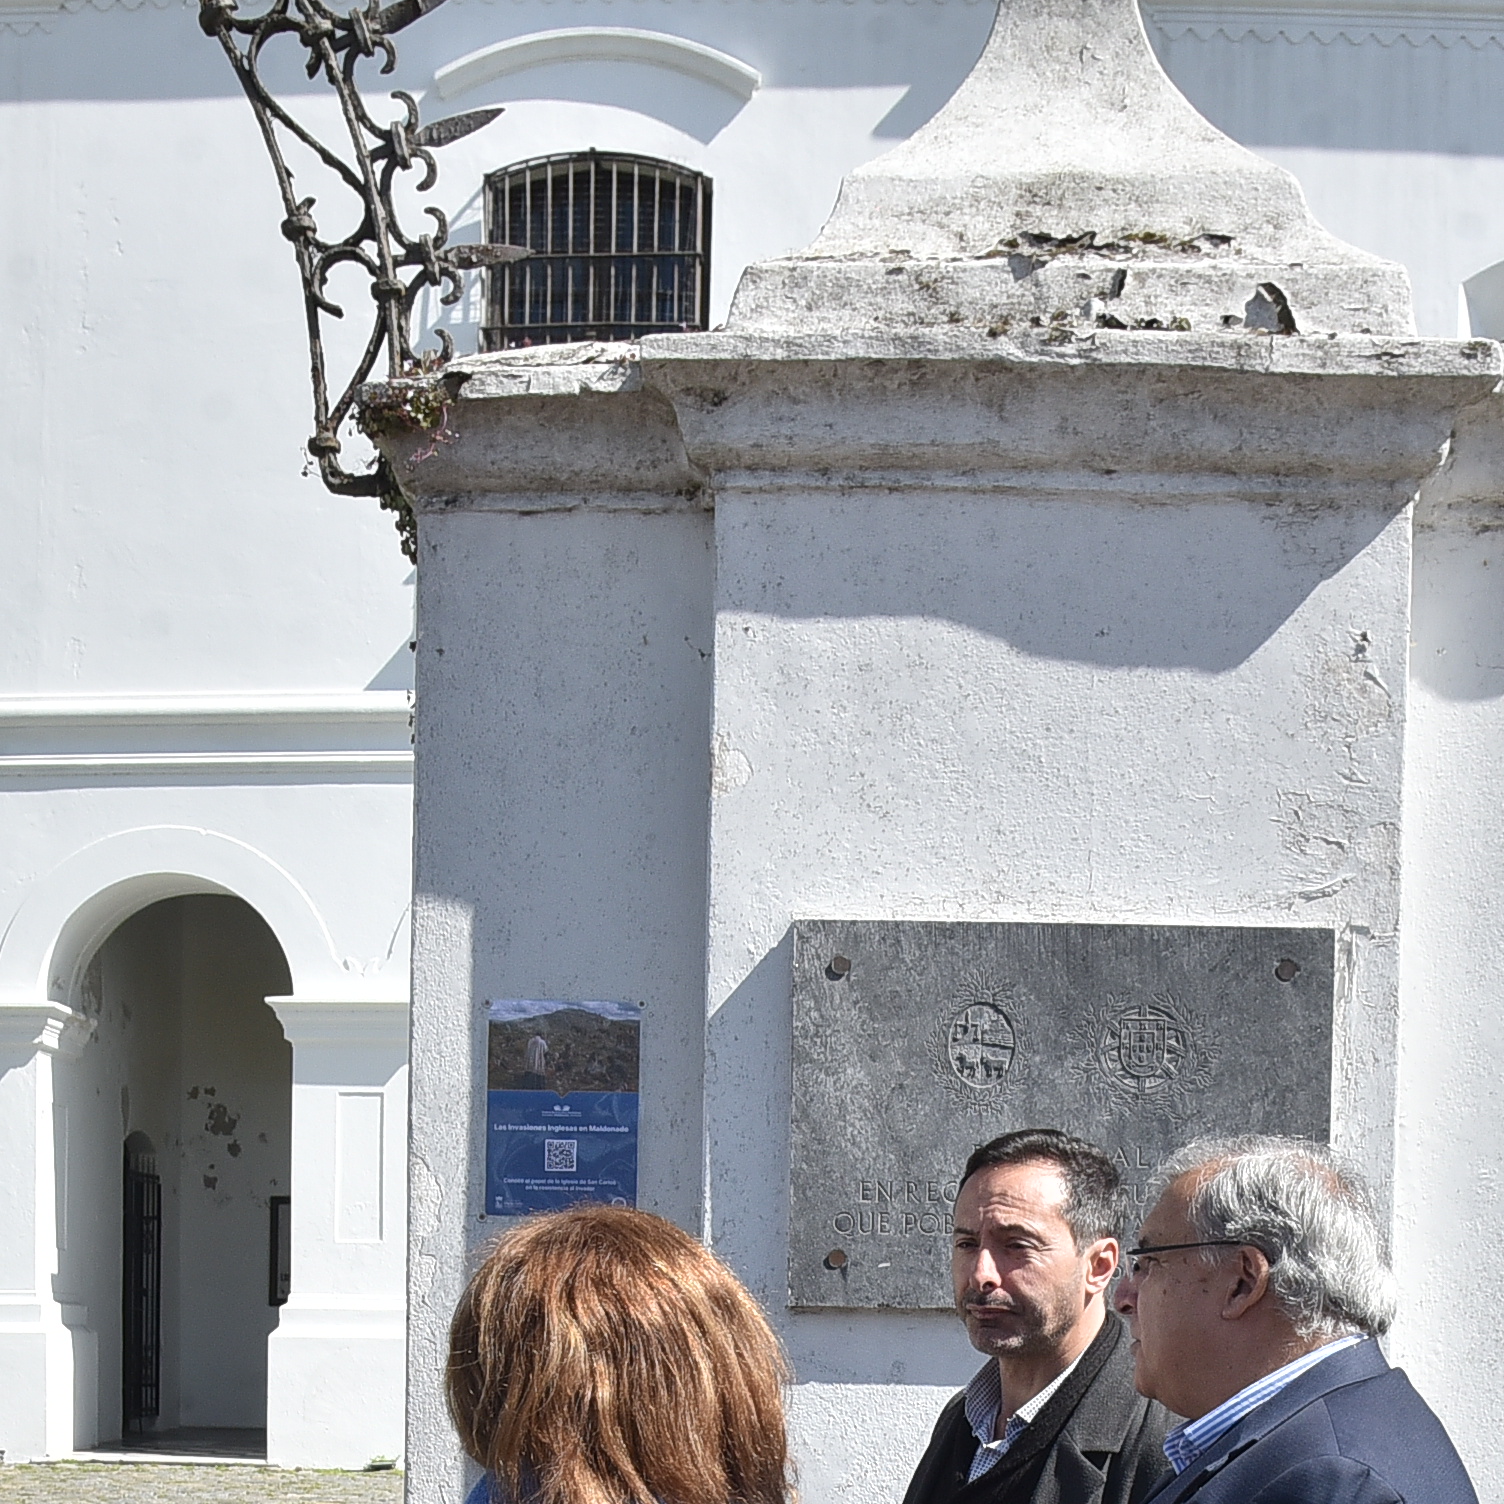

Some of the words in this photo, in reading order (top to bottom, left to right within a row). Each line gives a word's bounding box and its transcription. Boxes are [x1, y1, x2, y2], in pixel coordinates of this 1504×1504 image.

[508, 1123, 546, 1132] Invasiones
[548, 1124, 577, 1133] Inglesas
[589, 1124, 629, 1133] Maldonado
[859, 1180, 895, 1203] EN
[833, 1211, 891, 1239] QUE
